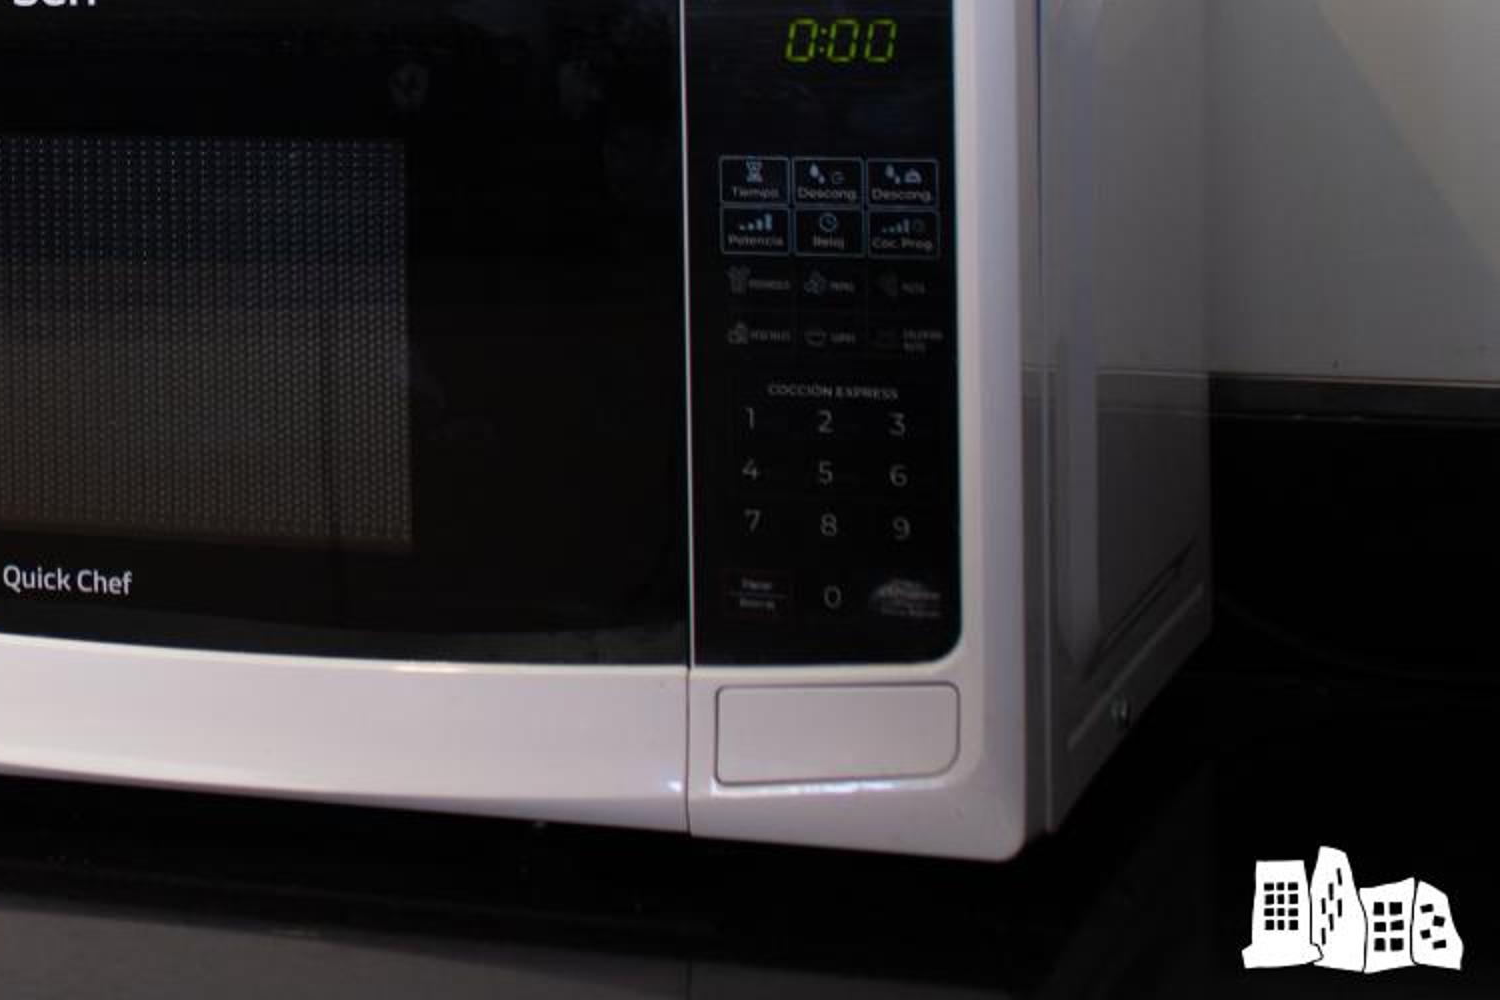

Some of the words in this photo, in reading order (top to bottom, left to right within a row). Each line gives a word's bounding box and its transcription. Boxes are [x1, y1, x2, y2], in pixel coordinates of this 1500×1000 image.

[785, 18, 898, 62] 0:00
[731, 185, 779, 199] Tiempo
[728, 235, 784, 247] Potencia
[835, 385, 899, 400] EXPRESS
[745, 407, 756, 430] 1
[817, 409, 835, 433] 2
[889, 411, 907, 436] 3
[741, 458, 760, 481] 4
[818, 460, 834, 484] 5
[889, 464, 908, 487] 6
[744, 508, 761, 532] 7
[819, 513, 838, 537] 8
[892, 516, 911, 541] 9
[3, 565, 72, 593] Quick
[77, 569, 133, 595] Chef
[823, 585, 842, 609] 0
